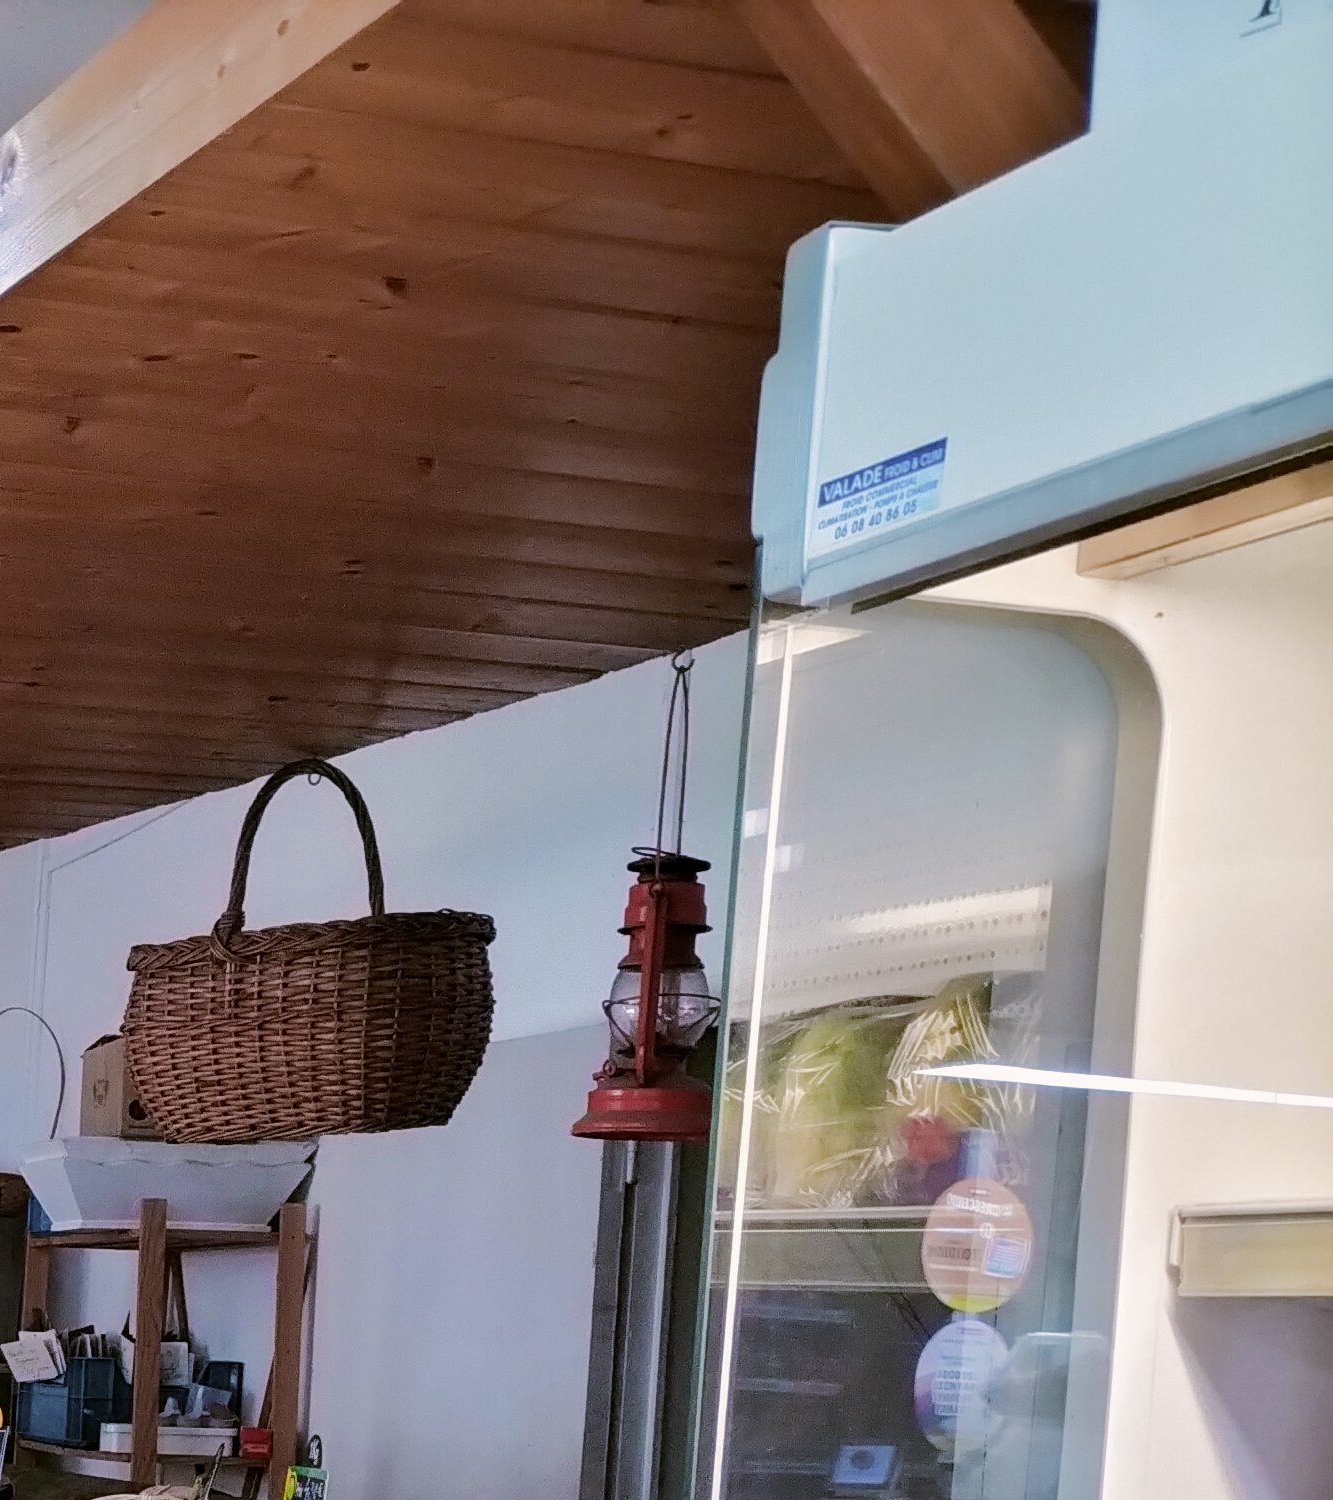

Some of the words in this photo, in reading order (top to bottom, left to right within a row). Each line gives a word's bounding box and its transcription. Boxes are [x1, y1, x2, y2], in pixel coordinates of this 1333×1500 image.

[824, 465, 883, 502] VALADE
[834, 524, 847, 540] 06
[851, 518, 864, 534] 08
[868, 511, 882, 527] 40
[885, 505, 899, 521] 86
[903, 499, 917, 515] 05
